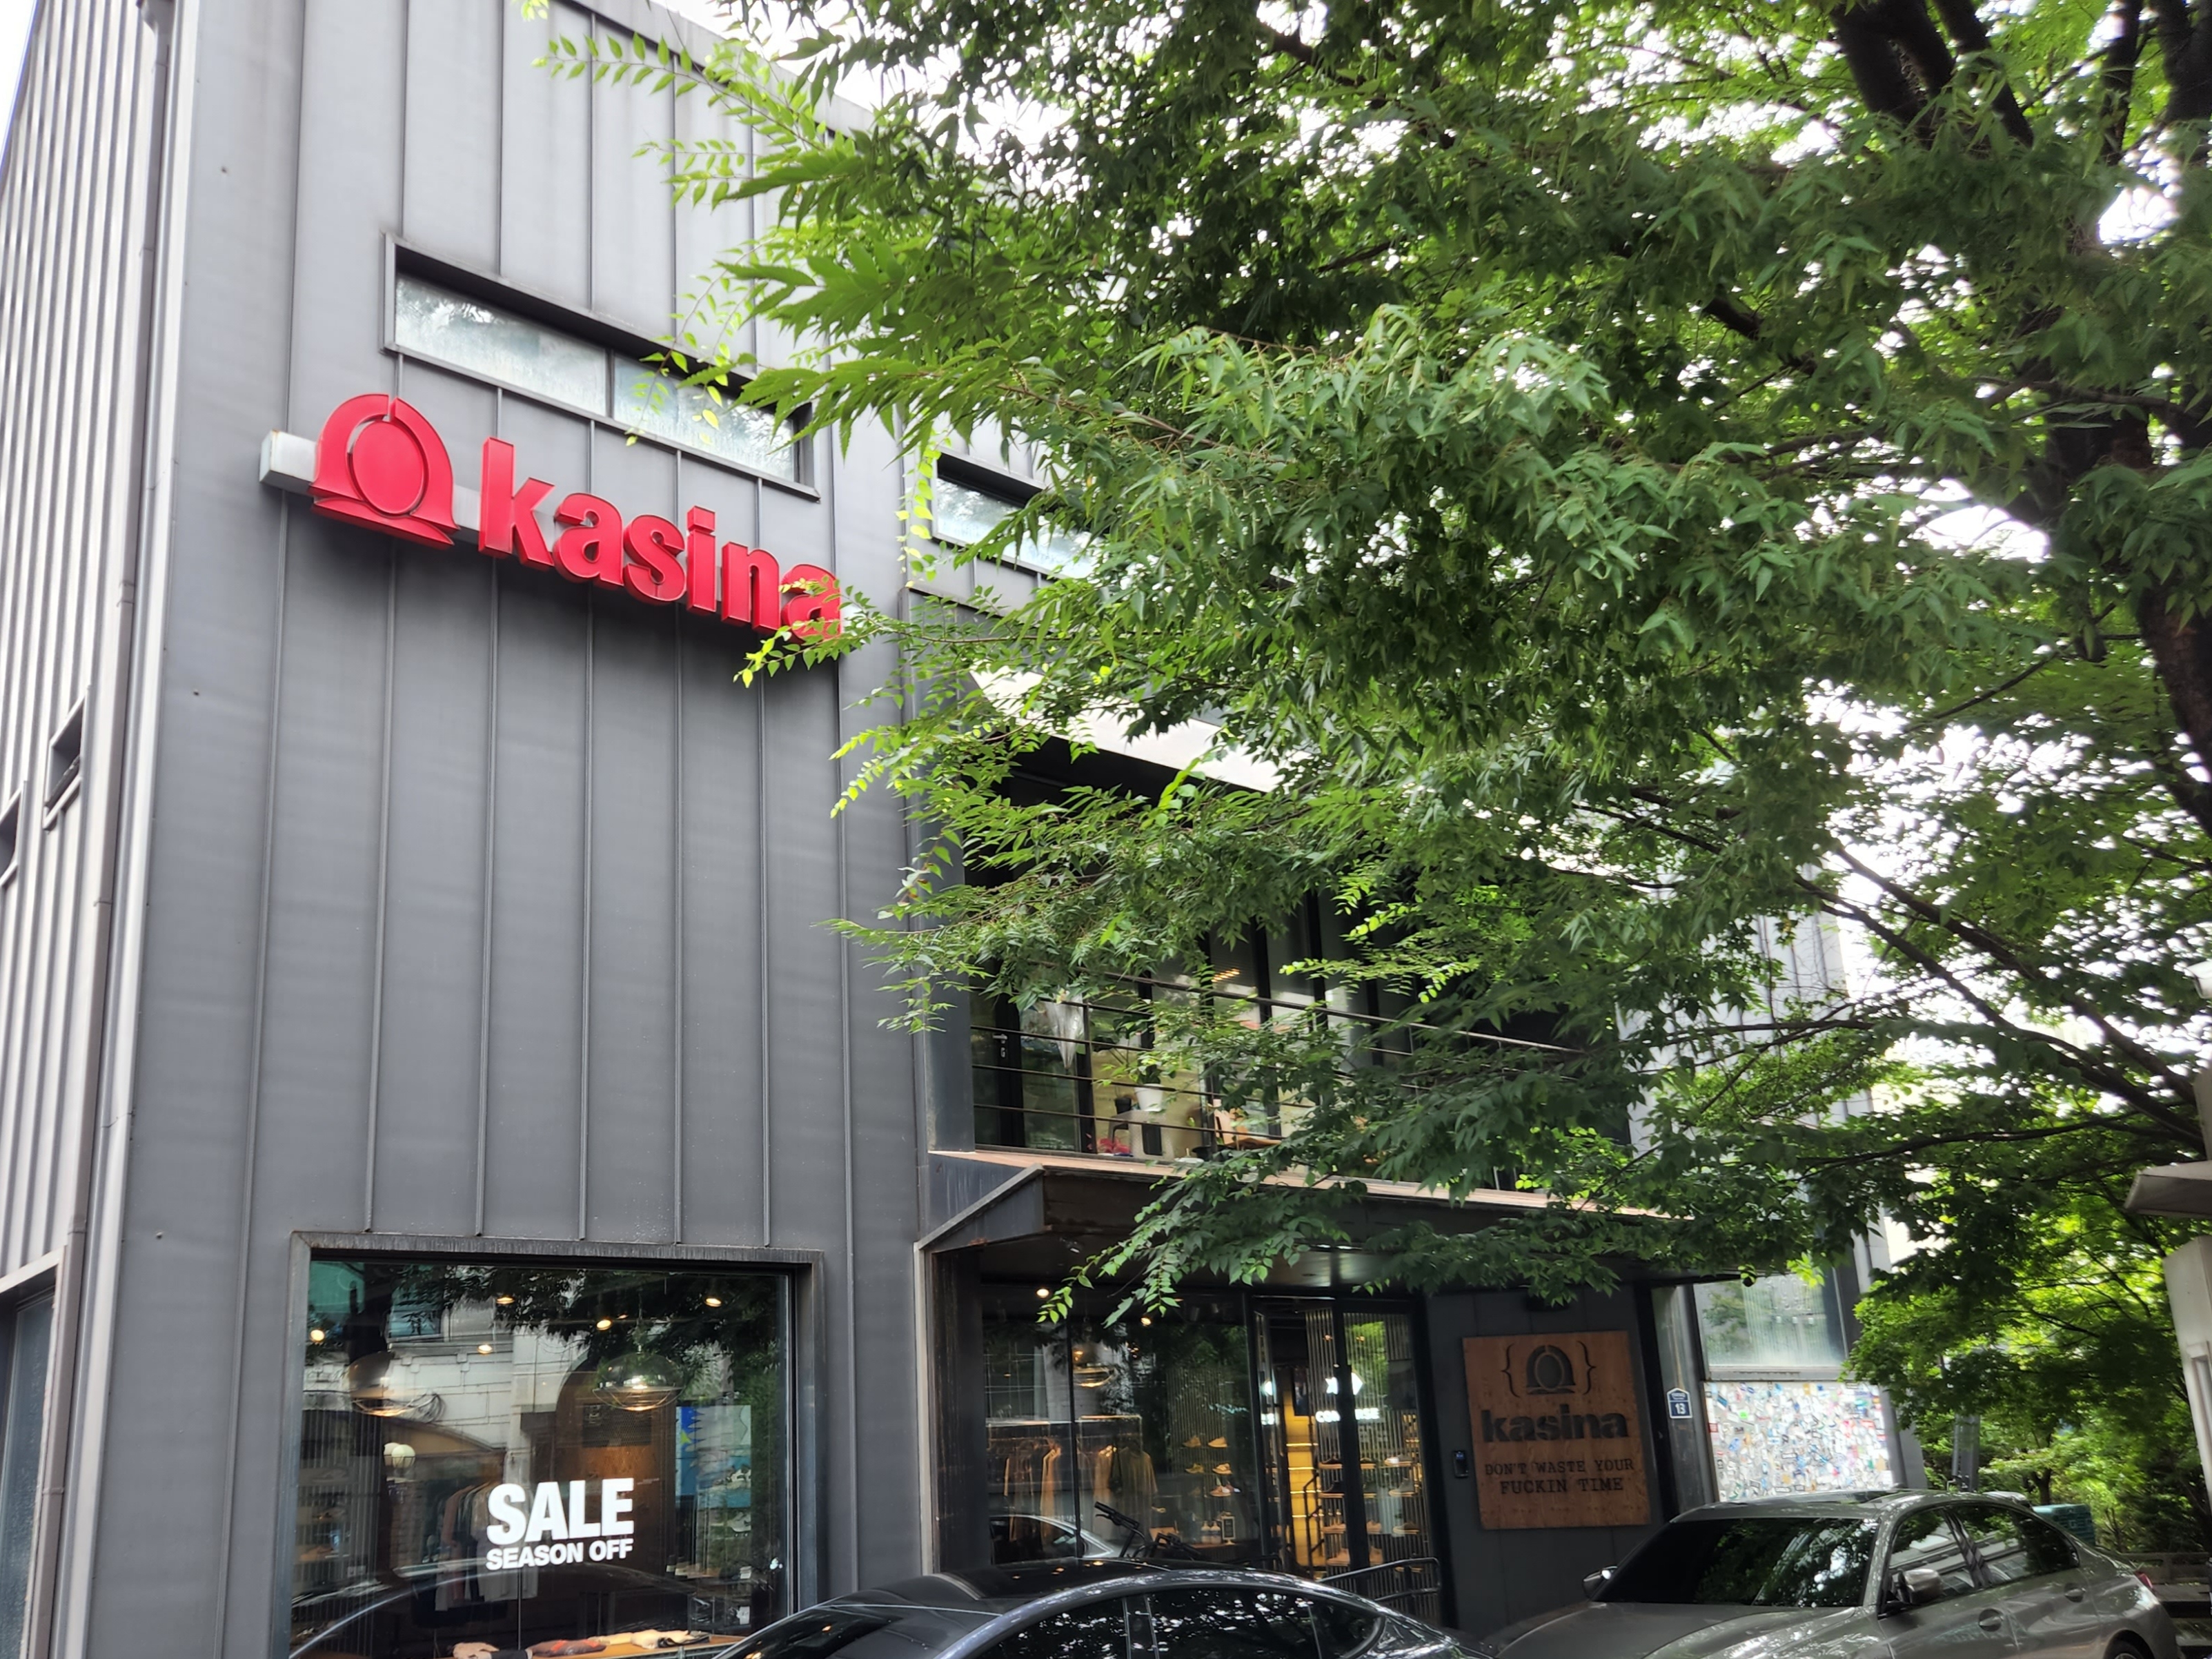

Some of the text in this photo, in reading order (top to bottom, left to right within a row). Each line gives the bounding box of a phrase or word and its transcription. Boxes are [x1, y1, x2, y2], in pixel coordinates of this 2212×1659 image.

[479, 437, 841, 643] kasina
[1315, 1408, 1380, 1422] CONRSE
[1675, 1403, 1686, 1414] 13
[1481, 1404, 1629, 1442] kasina
[1485, 1458, 1635, 1475] DON'T WASTE YOUR
[1501, 1478, 1624, 1494] FUCKIN TIME
[486, 1478, 634, 1545] SALE
[486, 1538, 634, 1571] SEASON OFF
